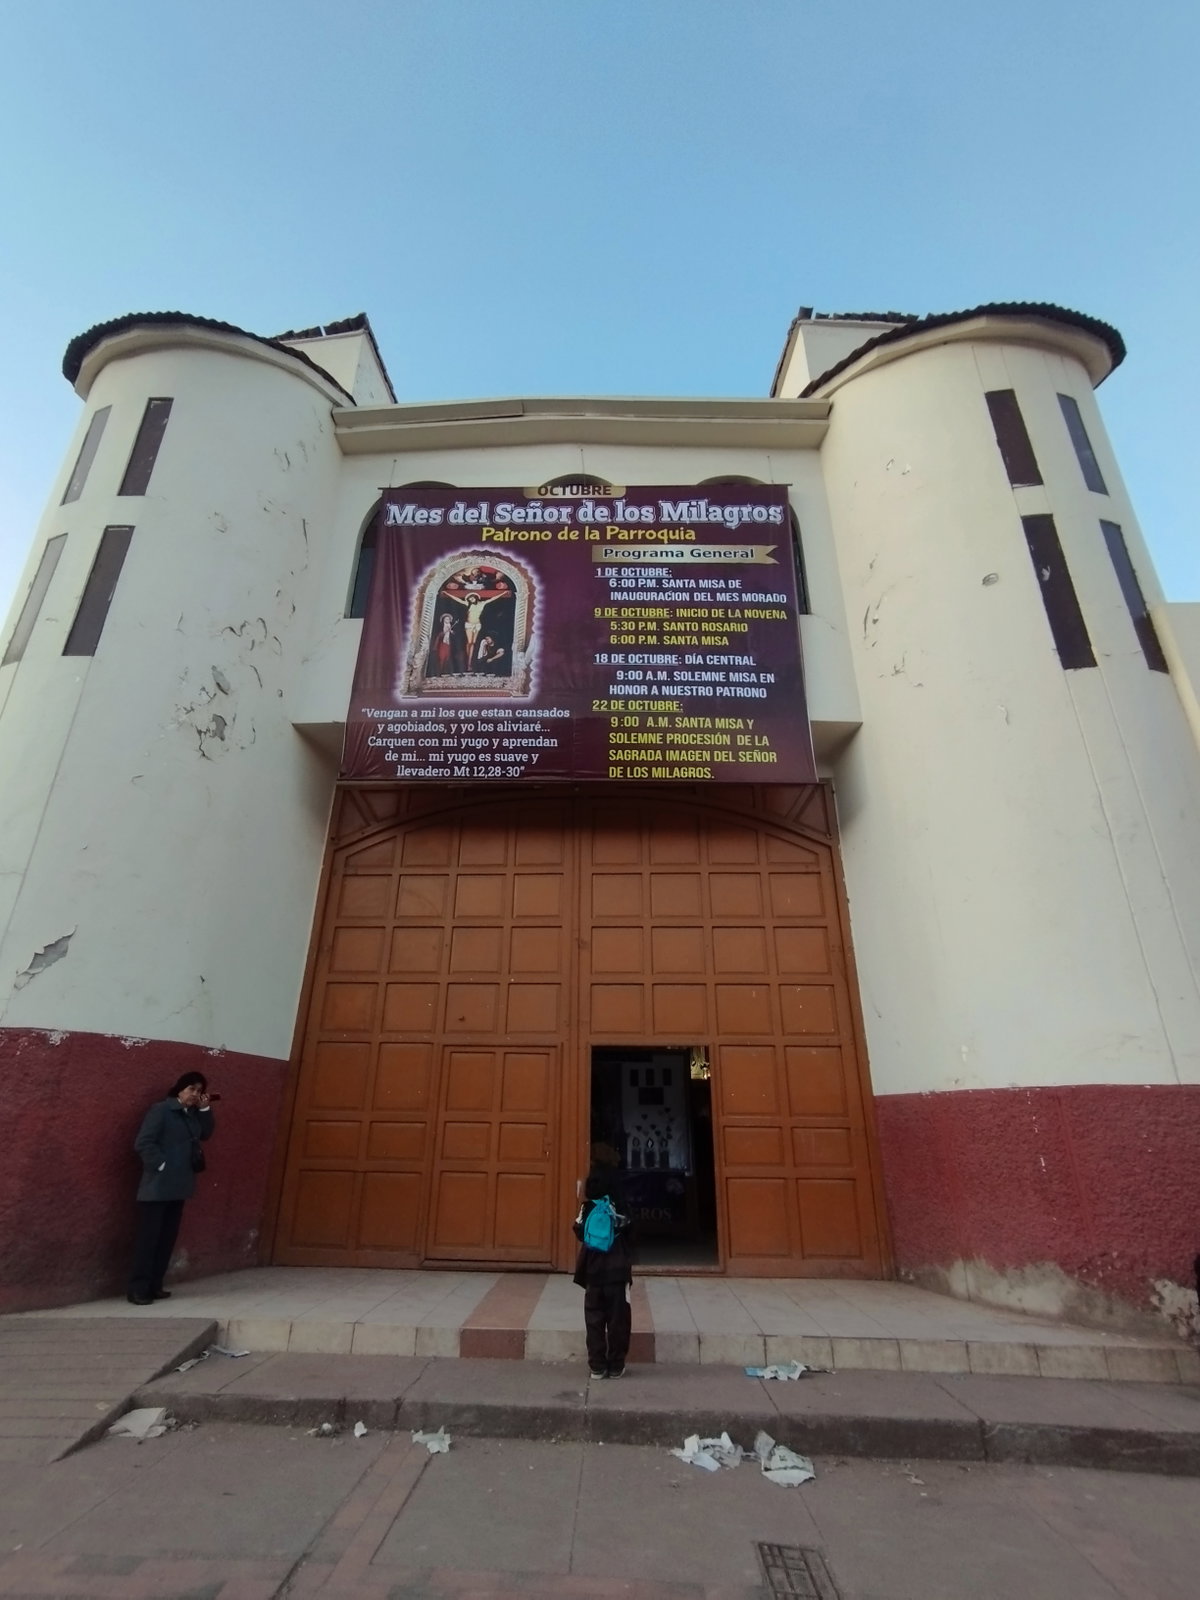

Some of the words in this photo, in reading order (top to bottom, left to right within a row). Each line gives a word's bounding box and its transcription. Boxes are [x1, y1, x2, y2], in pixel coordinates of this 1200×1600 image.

[538, 484, 612, 496] OCTUBRE
[386, 503, 444, 525] Mes
[449, 502, 490, 525] del
[494, 501, 572, 525] Señor
[578, 500, 611, 524] de
[613, 500, 655, 524] los
[659, 500, 784, 528] Milagros
[481, 527, 552, 541] Patrono
[557, 526, 580, 541] de
[584, 526, 600, 540] la
[606, 525, 696, 543] Parroquia
[603, 548, 684, 560] Programa
[690, 548, 755, 559] General
[596, 568, 602, 577] 1
[605, 568, 620, 577] DE
[621, 568, 673, 577] OCTUBRE:
[609, 578, 635, 588] 6:00
[638, 579, 660, 588] P.M.
[662, 579, 696, 589] SANTA
[699, 580, 726, 589] MISA
[729, 580, 742, 589] DE
[694, 592, 714, 602] DEL
[717, 593, 740, 602] MES
[742, 593, 787, 603] MORADO
[594, 607, 602, 617] 9
[604, 608, 619, 617] DE
[621, 608, 673, 618] OCTUBRE:
[676, 609, 709, 618] INICIO
[712, 609, 725, 618] DE
[728, 609, 741, 618] LA
[744, 609, 787, 620] NOVENA
[610, 621, 635, 631] 5:30
[639, 622, 660, 631] P.M.
[663, 622, 699, 631] SANTO
[702, 623, 748, 632] ROSARIO
[610, 635, 635, 644] 6:00
[639, 635, 660, 645] P.M.
[663, 635, 699, 645] SANTA
[702, 636, 729, 646] MISA
[594, 653, 608, 663] 18
[611, 653, 625, 663] DE
[628, 654, 682, 665] OCTUBRE:
[685, 653, 703, 665] DÍA
[706, 655, 756, 666] CENTRAL
[616, 670, 643, 680] 9:00
[646, 671, 670, 681] A.M.
[673, 671, 726, 682] SOLEMNE
[729, 672, 757, 682] MISA
[760, 673, 775, 683] EN
[609, 685, 648, 695] HONOR
[651, 685, 659, 695] A
[662, 686, 713, 696] NUESTRO
[716, 687, 767, 698] PATRONO
[592, 700, 608, 710] 22
[611, 700, 625, 710] DE
[628, 701, 683, 711] OCTUBRE:
[411, 710, 418, 718] a
[438, 708, 455, 718] los
[458, 709, 478, 720] que
[481, 708, 513, 718] estan
[516, 707, 570, 718] cansados
[377, 724, 385, 734] y
[387, 721, 448, 733] agobiados,
[450, 724, 457, 734] y
[459, 724, 475, 734] yo
[477, 721, 494, 732] los
[647, 717, 672, 728] A.M.
[675, 717, 712, 728] SANTA
[715, 718, 744, 729] MISA
[747, 719, 754, 730] Y
[418, 738, 438, 747] con
[442, 736, 458, 747] mi
[460, 738, 489, 749] yugo
[492, 738, 499, 749] y
[503, 736, 558, 749] aprendan
[609, 733, 663, 744] SOLEMNE
[666, 732, 730, 745] PROCESIÓN
[737, 735, 752, 745] DE
[755, 735, 769, 746] LA
[385, 751, 399, 761] de
[428, 751, 444, 762] mi
[447, 753, 475, 764] yugo
[478, 753, 491, 762] es
[494, 753, 528, 762] suave
[531, 753, 539, 764] y
[609, 750, 663, 761] SAGRADA
[666, 750, 711, 762] IMAGEN
[714, 751, 735, 762] DEL
[738, 749, 777, 763] SEÑOR
[397, 765, 451, 777] llevadero
[453, 766, 470, 777] Mt
[609, 767, 623, 778] DE
[626, 767, 648, 778] LOS
[652, 767, 715, 778] MILAGROS.
